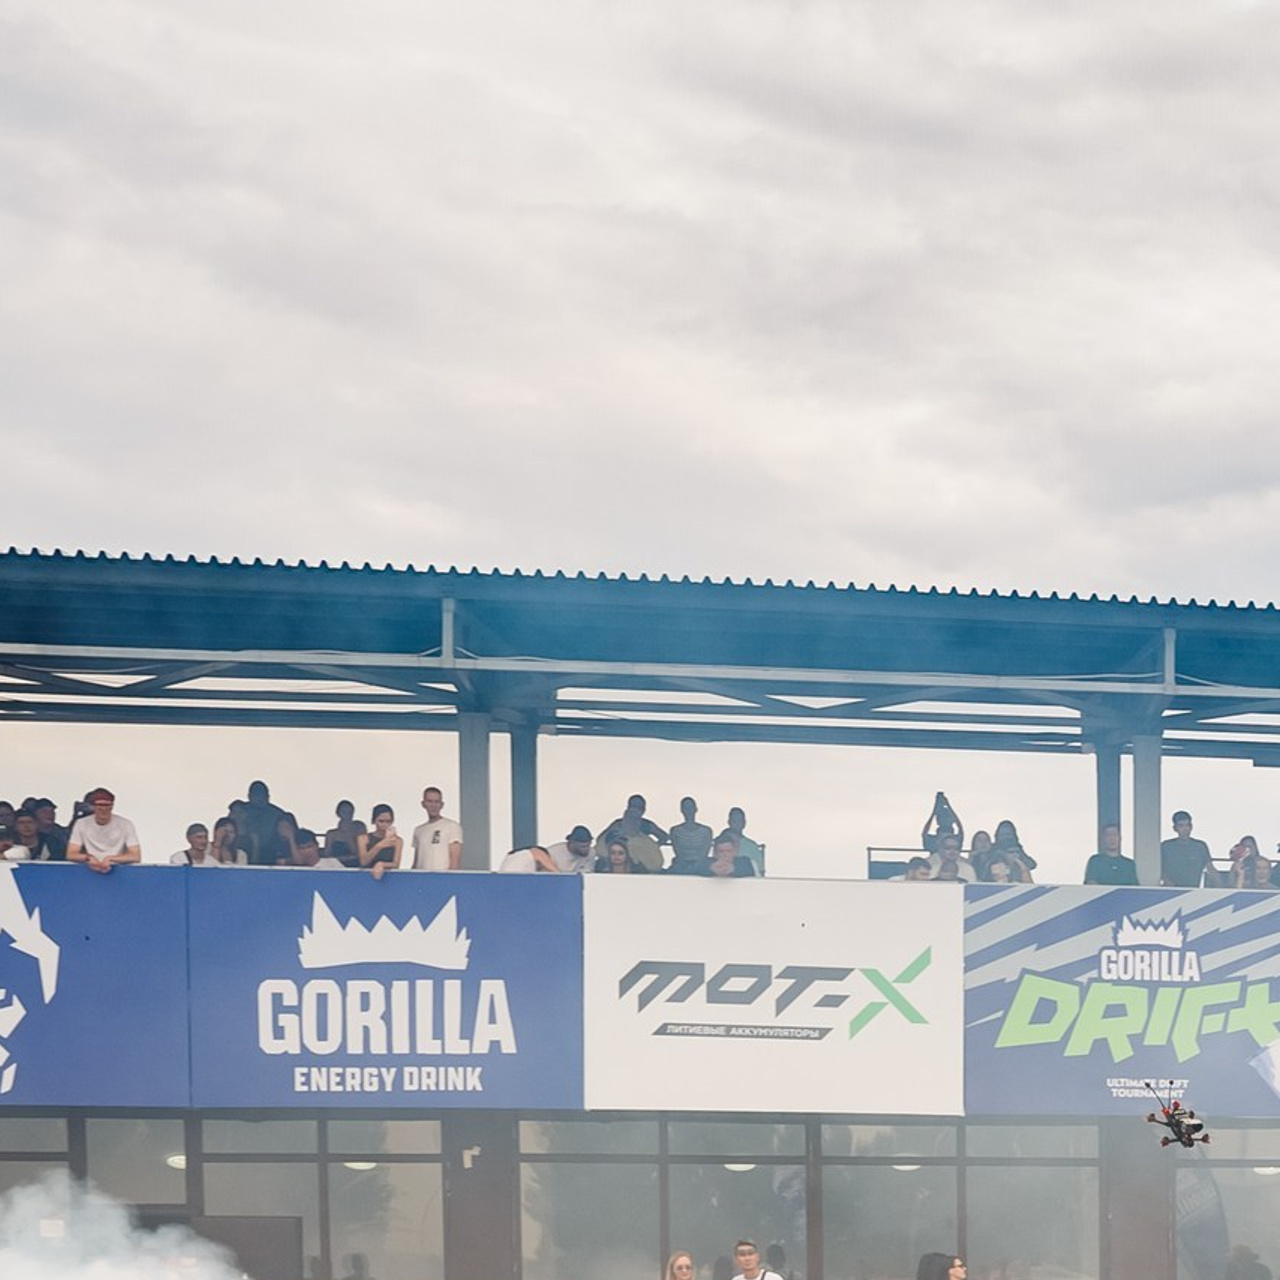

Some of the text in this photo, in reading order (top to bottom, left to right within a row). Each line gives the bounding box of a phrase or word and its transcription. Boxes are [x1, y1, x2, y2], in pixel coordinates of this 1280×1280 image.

[1100, 949, 1201, 982] GORILLA
[257, 979, 518, 1056] GORILLA
[666, 1024, 820, 1038] ЛИТИЕВЫЕ АККУМУЛЯТОРЫ
[293, 1065, 484, 1093] ENERGY DRINK
[1106, 1078, 1157, 1088] ULTIMATE
[1110, 1088, 1186, 1099] TOURNAMENT
